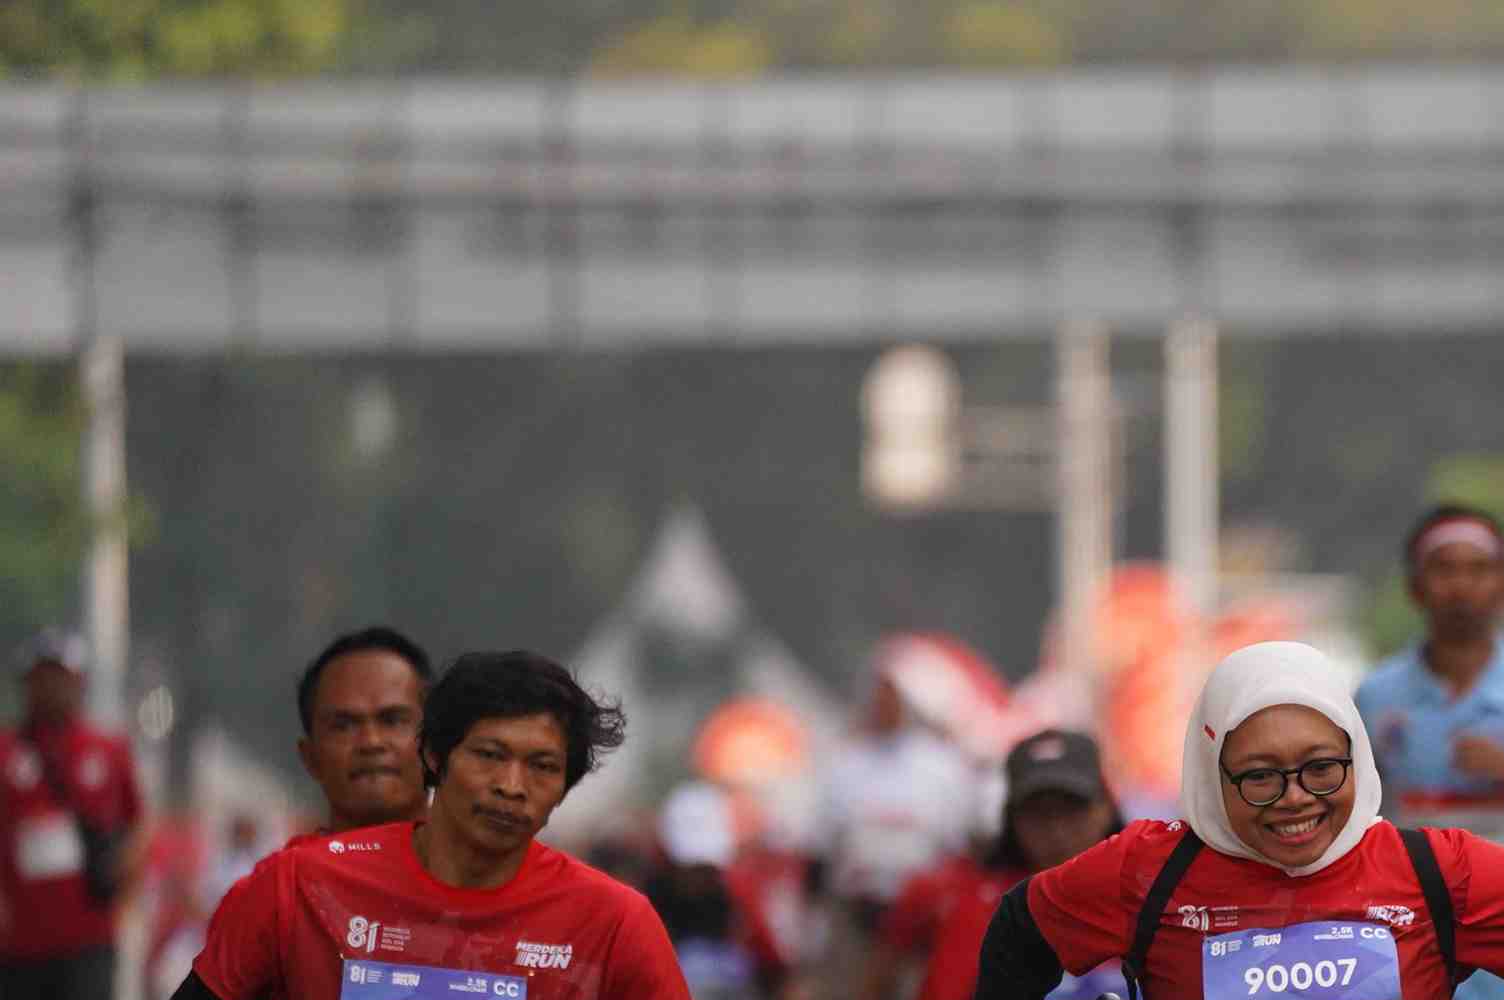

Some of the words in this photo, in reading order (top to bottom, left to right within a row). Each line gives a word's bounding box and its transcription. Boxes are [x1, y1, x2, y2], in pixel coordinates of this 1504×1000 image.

[348, 841, 382, 851] MILLS
[347, 915, 381, 953] 81
[1360, 927, 1388, 939] CC
[515, 941, 573, 954] MERDEKA
[1211, 941, 1227, 957] 81
[521, 951, 573, 970] RUN
[350, 964, 366, 985] 81
[1243, 957, 1358, 996] 90007
[493, 980, 519, 998] CC
